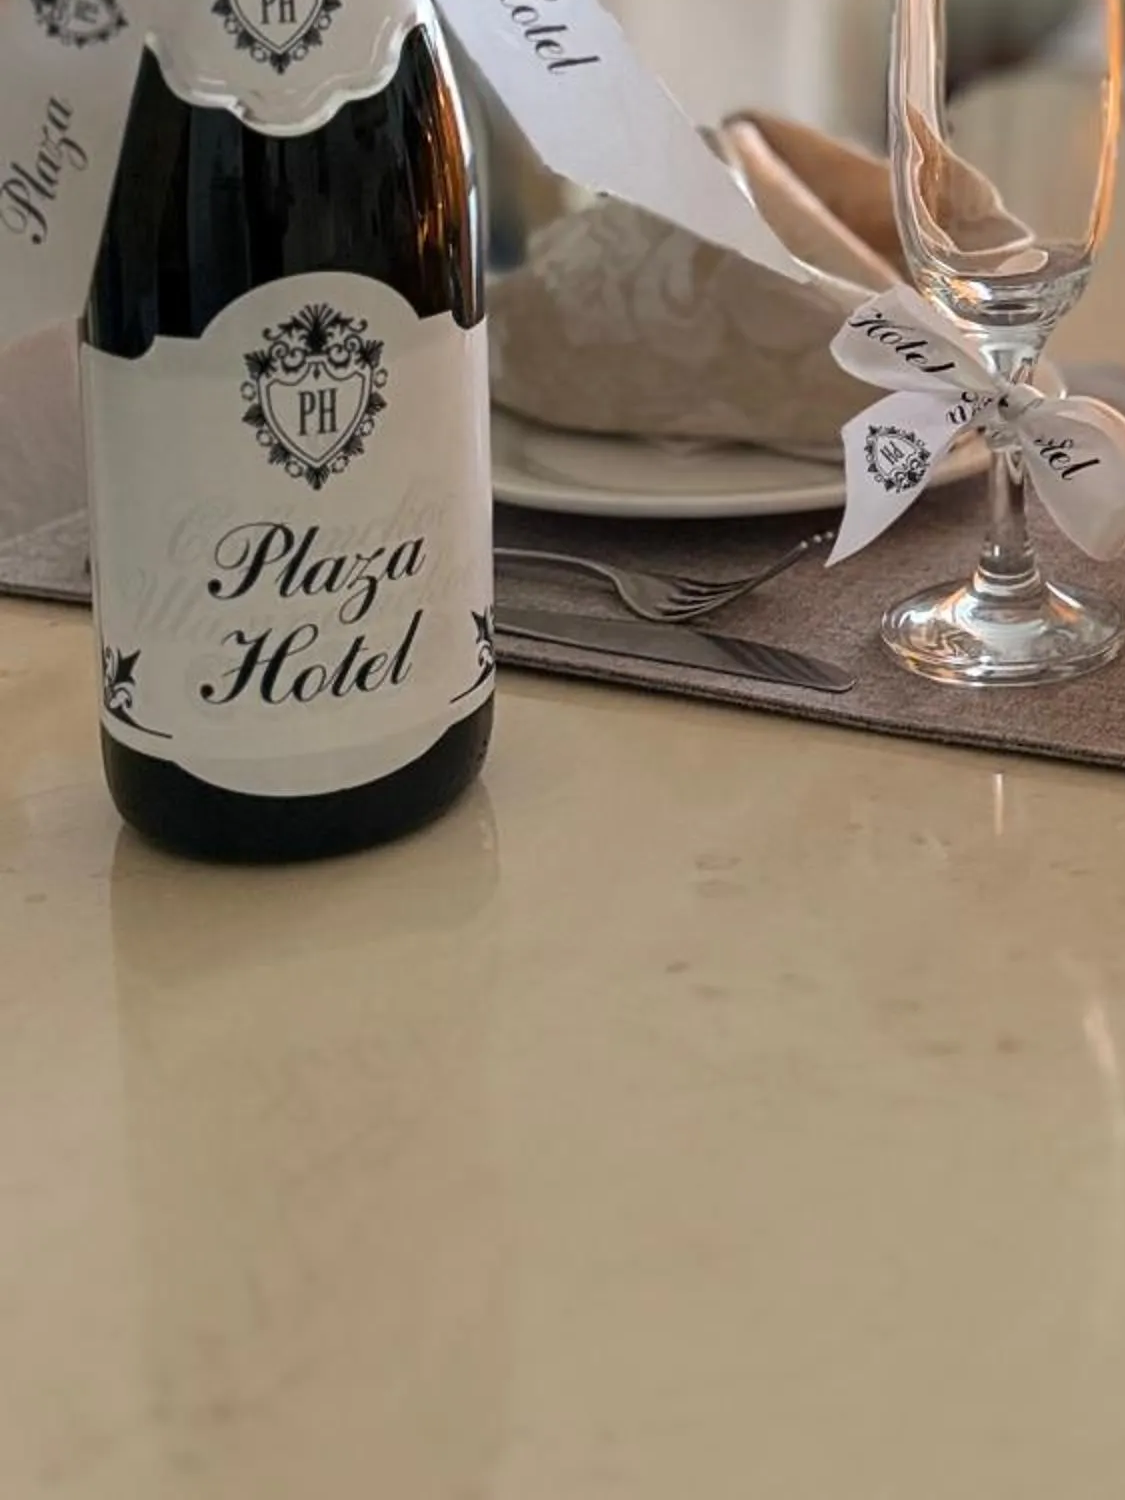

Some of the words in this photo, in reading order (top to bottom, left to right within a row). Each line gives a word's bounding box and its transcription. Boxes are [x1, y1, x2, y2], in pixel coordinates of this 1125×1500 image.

[0, 97, 89, 244] Plaza
[848, 308, 955, 373] Hotel
[297, 387, 339, 437] PH
[207, 521, 425, 625] Plaza
[200, 608, 424, 704] Hotel
